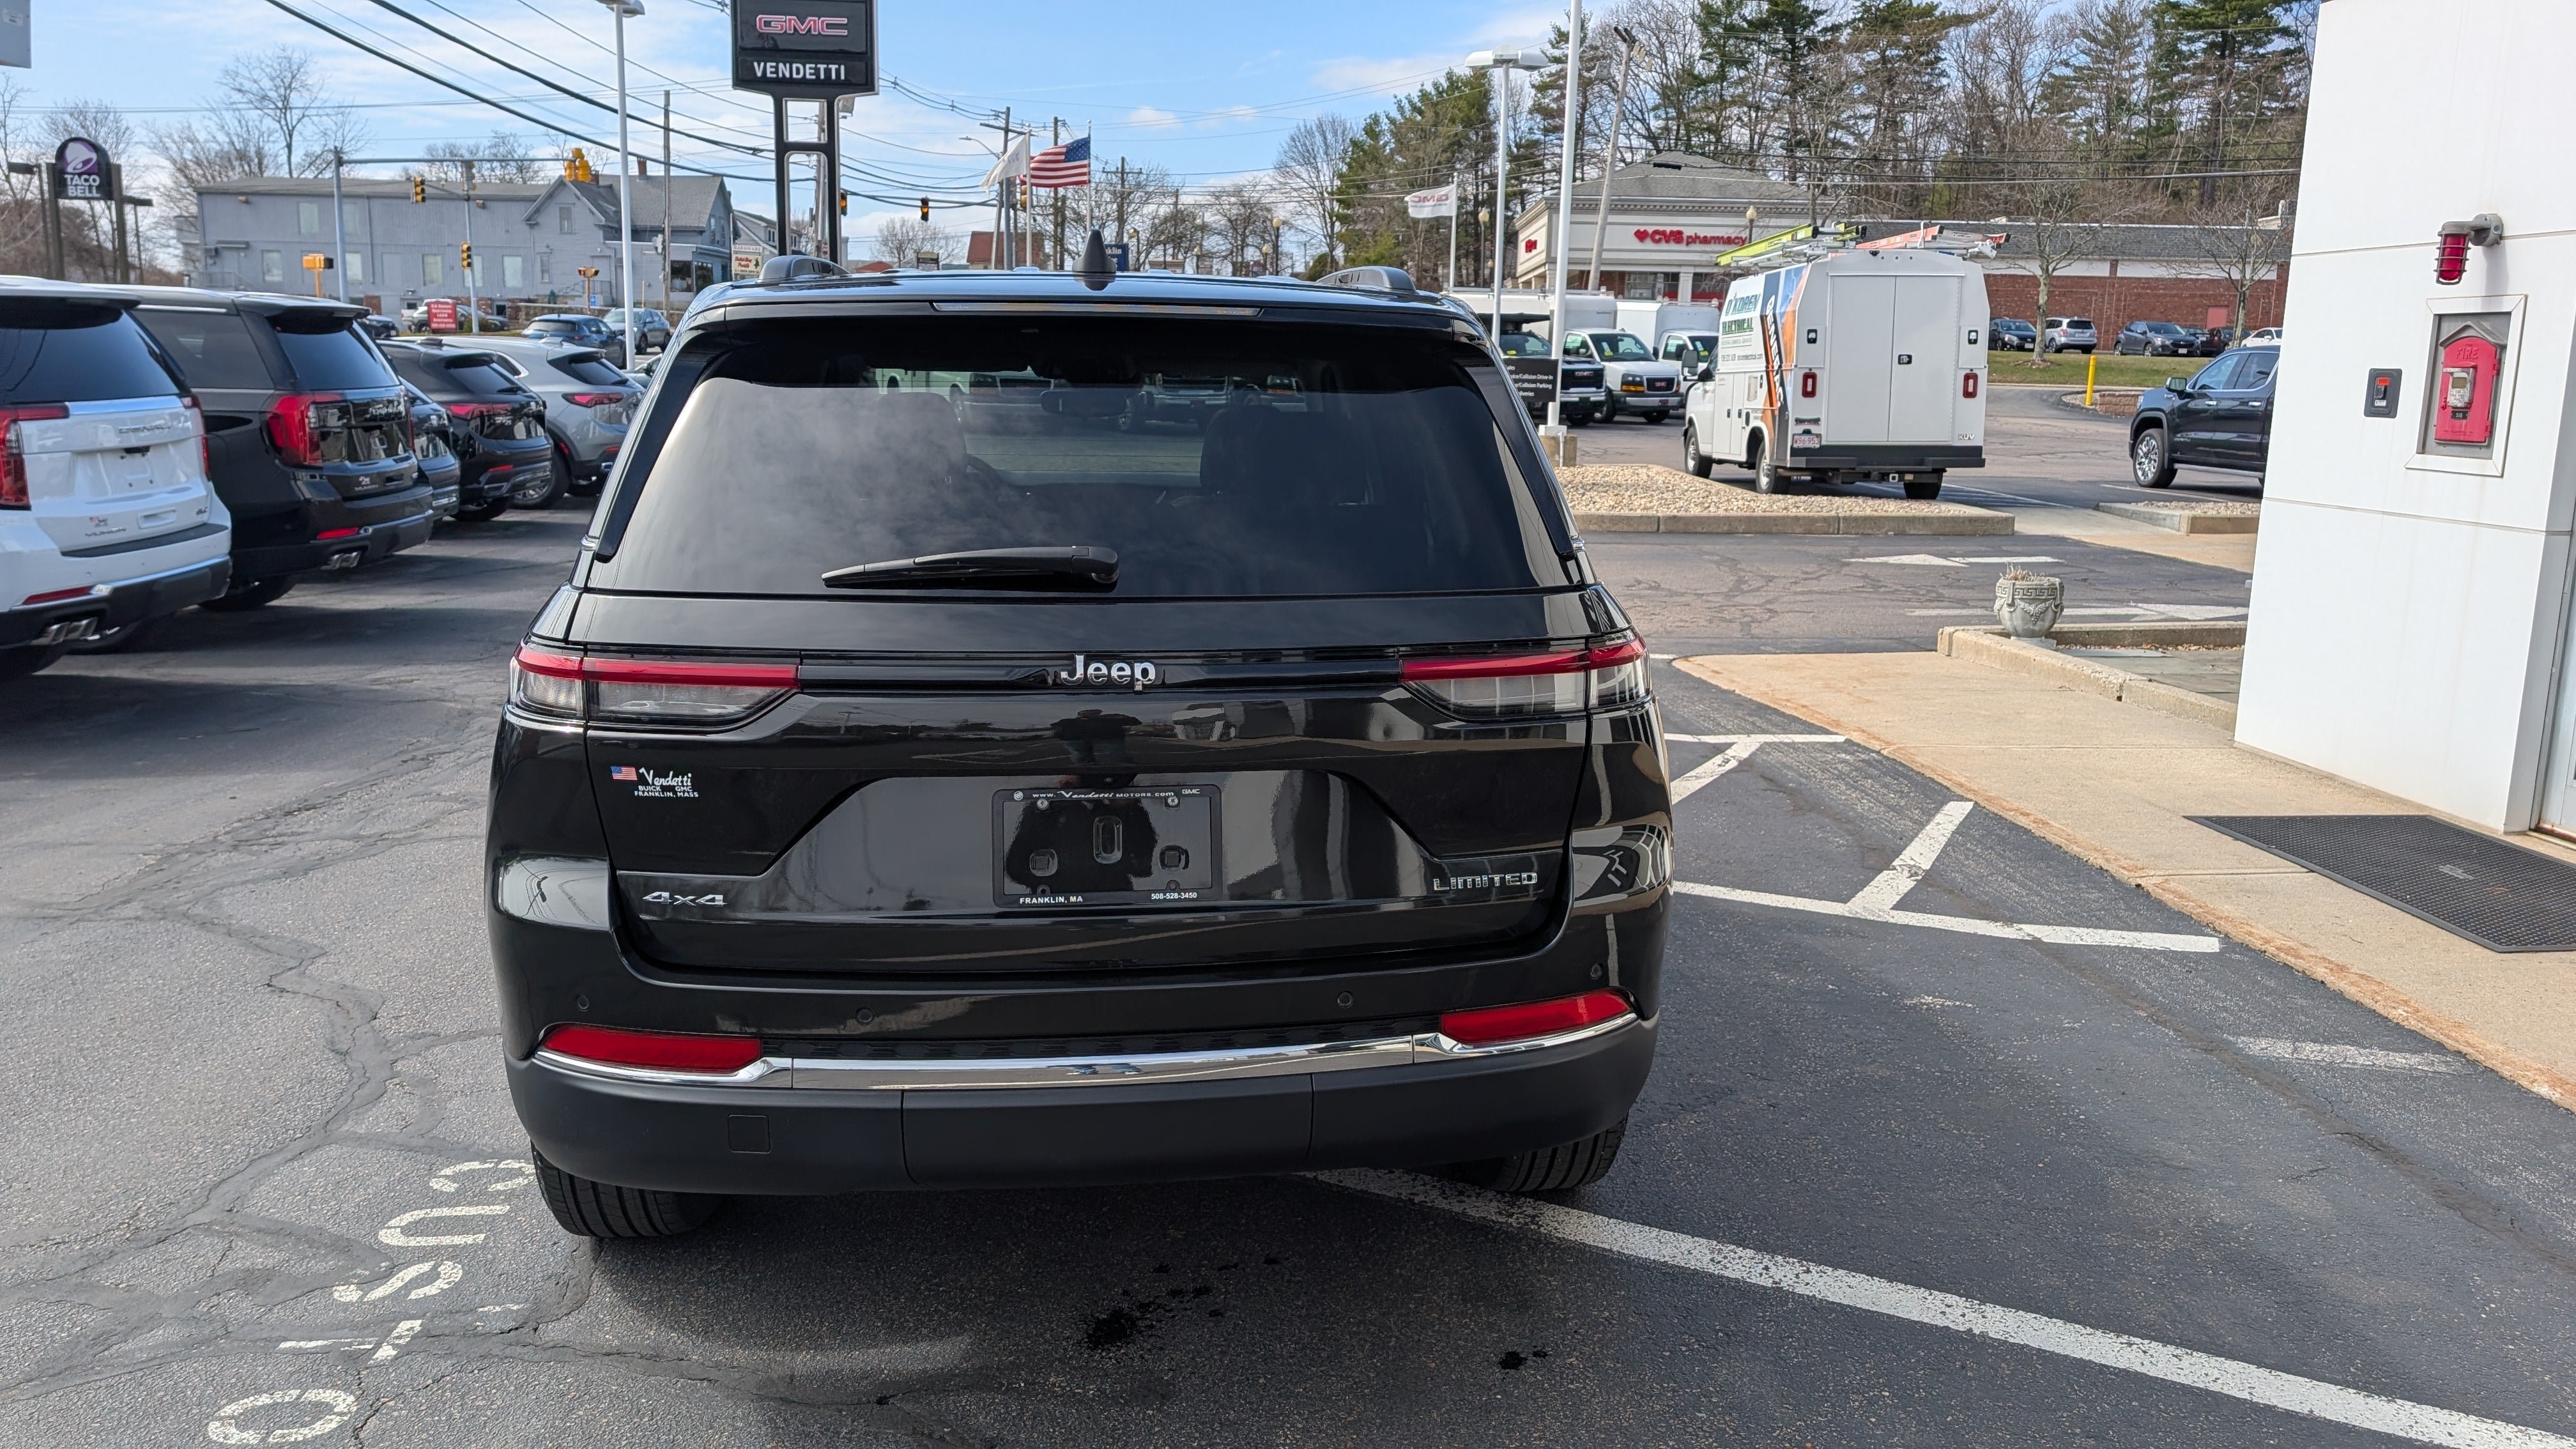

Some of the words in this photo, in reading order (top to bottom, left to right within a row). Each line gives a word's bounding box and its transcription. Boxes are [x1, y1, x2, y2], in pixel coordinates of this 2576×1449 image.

[756, 15, 848, 35] GMC
[754, 62, 845, 80] VENDETTI
[64, 174, 100, 186] TACO
[68, 186, 100, 197] BELL
[1650, 229, 1683, 244] CVS
[1685, 233, 1748, 247] pharmacy
[1721, 317, 1754, 336] ELECTRICAL
[1765, 294, 1784, 408] GENERAC
[2456, 347, 2479, 360] FIRE
[1060, 654, 1156, 691] Jeep
[639, 767, 692, 786] Vendetti
[1433, 872, 1538, 891] LIMITED
[643, 891, 728, 907] 4x4
[1020, 896, 1068, 904] FRANKLIN,
[207, 1158, 537, 1445] CUSTO
